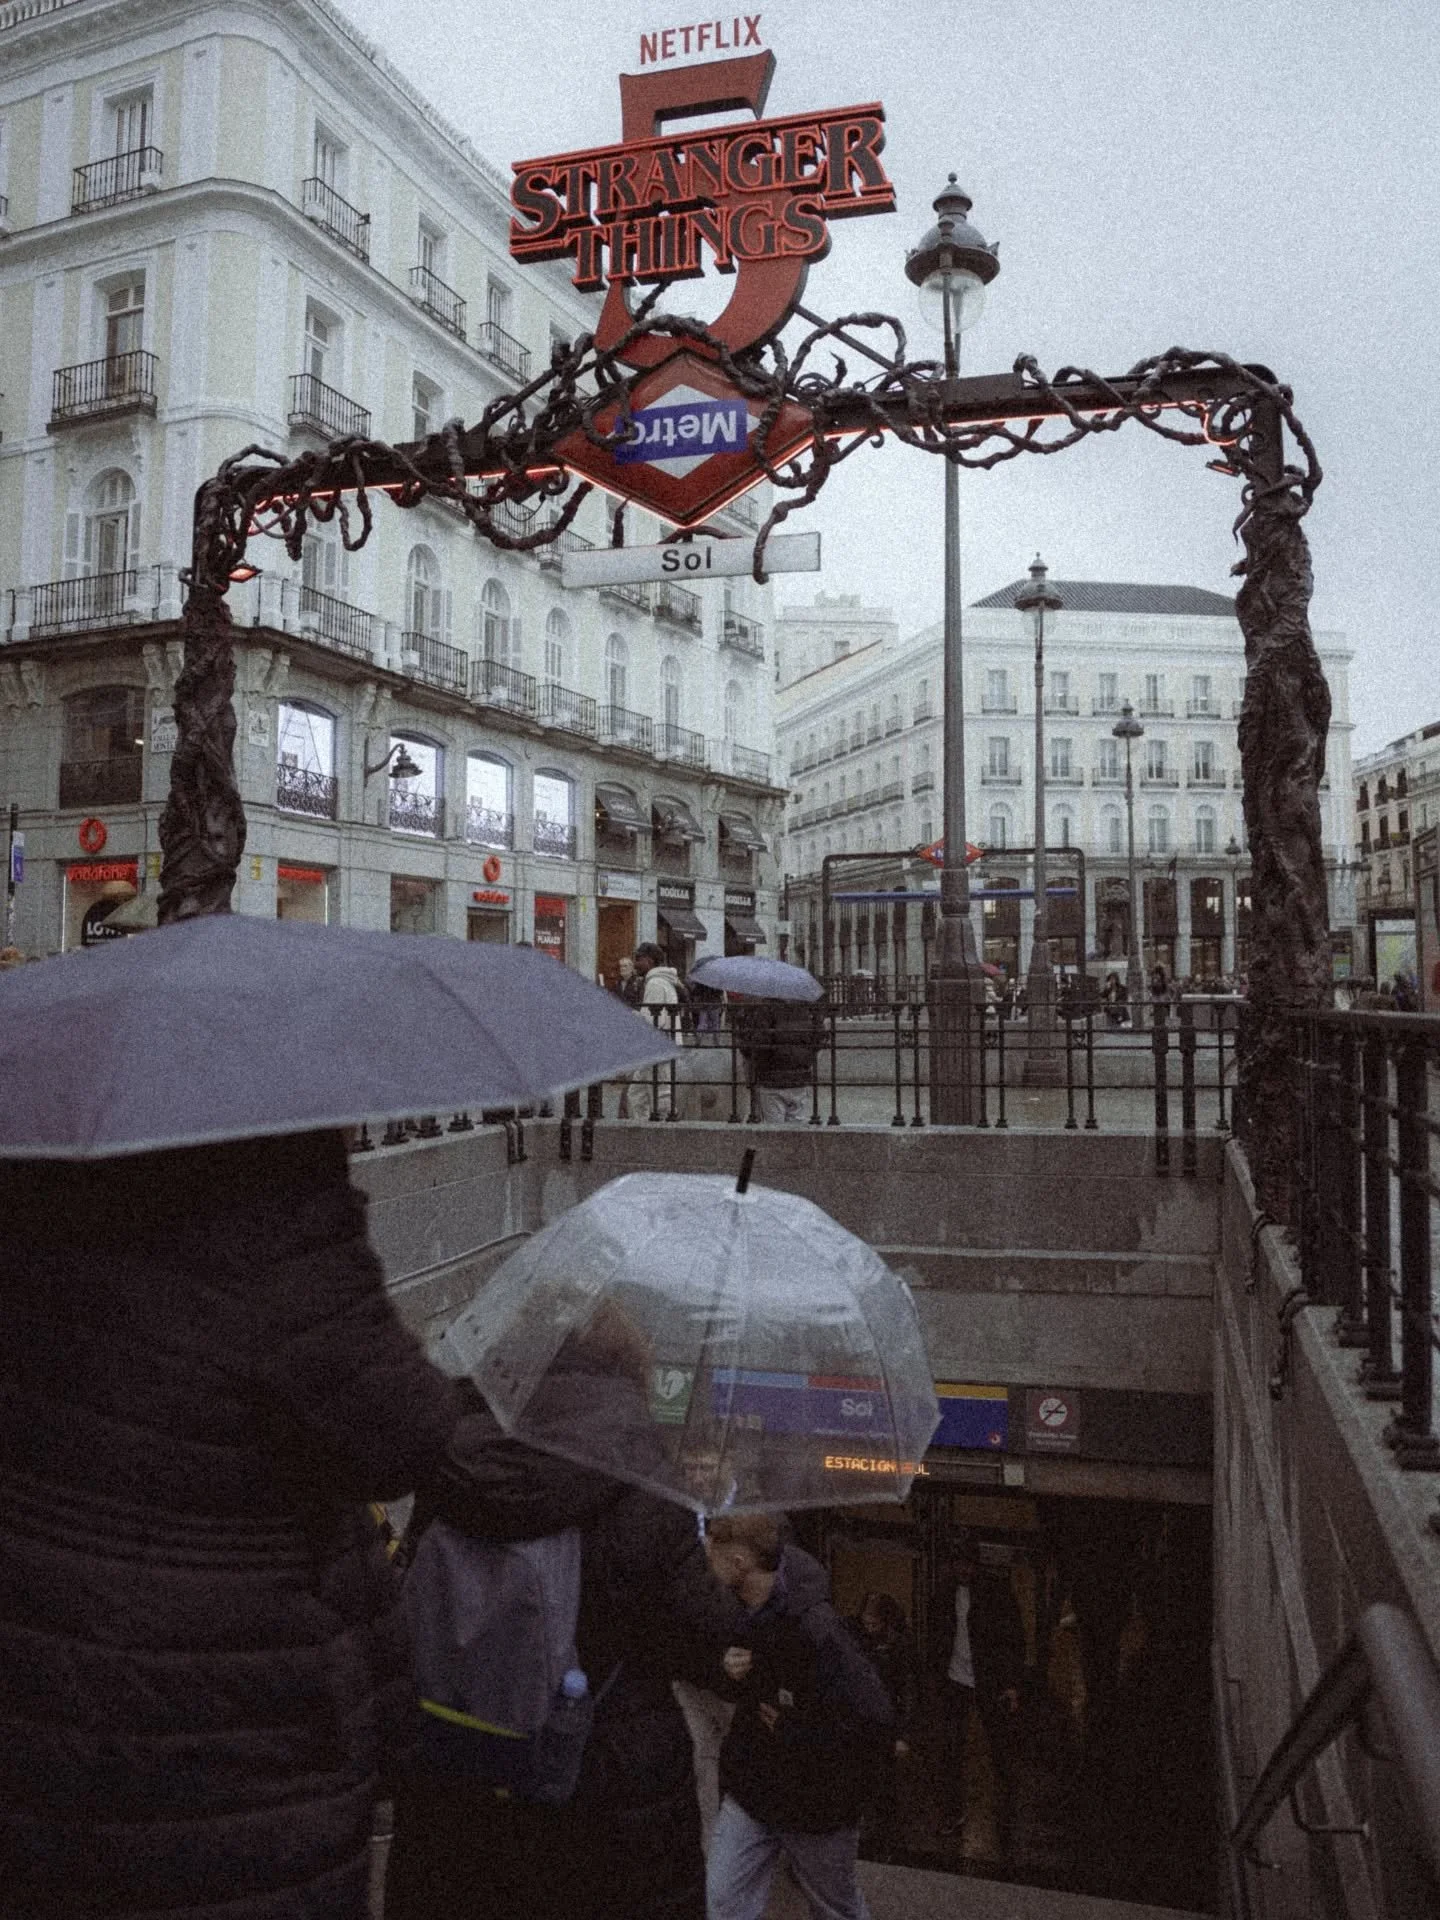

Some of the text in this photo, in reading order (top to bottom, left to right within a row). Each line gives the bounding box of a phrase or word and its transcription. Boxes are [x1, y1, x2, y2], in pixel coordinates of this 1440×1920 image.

[640, 14, 762, 65] NETFLIX
[509, 116, 893, 242] STRANGER
[564, 194, 831, 287] THINGS
[660, 546, 713, 572] Sol
[824, 1455, 897, 1473] ESTACION
